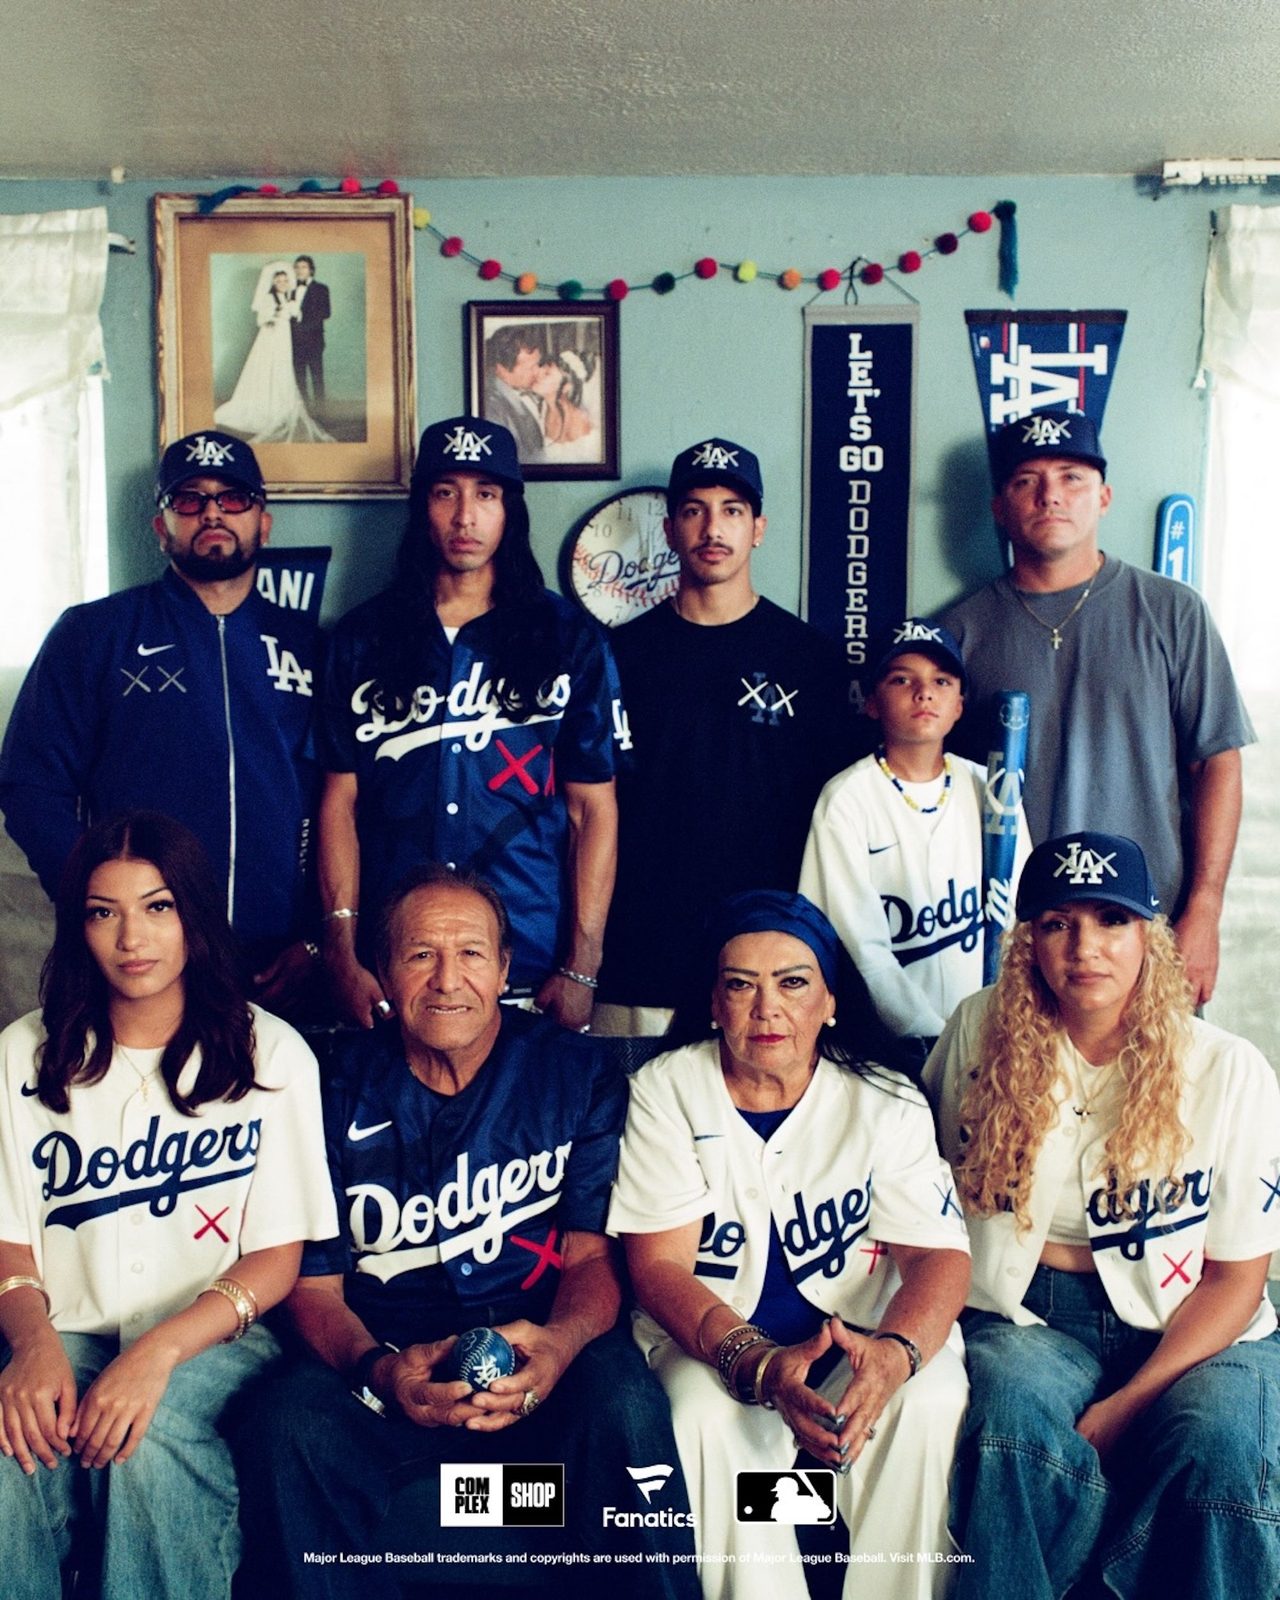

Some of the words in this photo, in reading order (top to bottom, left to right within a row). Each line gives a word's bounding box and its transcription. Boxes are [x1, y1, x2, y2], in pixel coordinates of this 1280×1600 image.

[847, 332, 882, 441] LET'S
[990, 344, 1109, 425] LA
[839, 445, 884, 472] GO
[256, 567, 315, 611] ANI
[843, 479, 872, 665] DODGERS
[260, 634, 313, 697] LA
